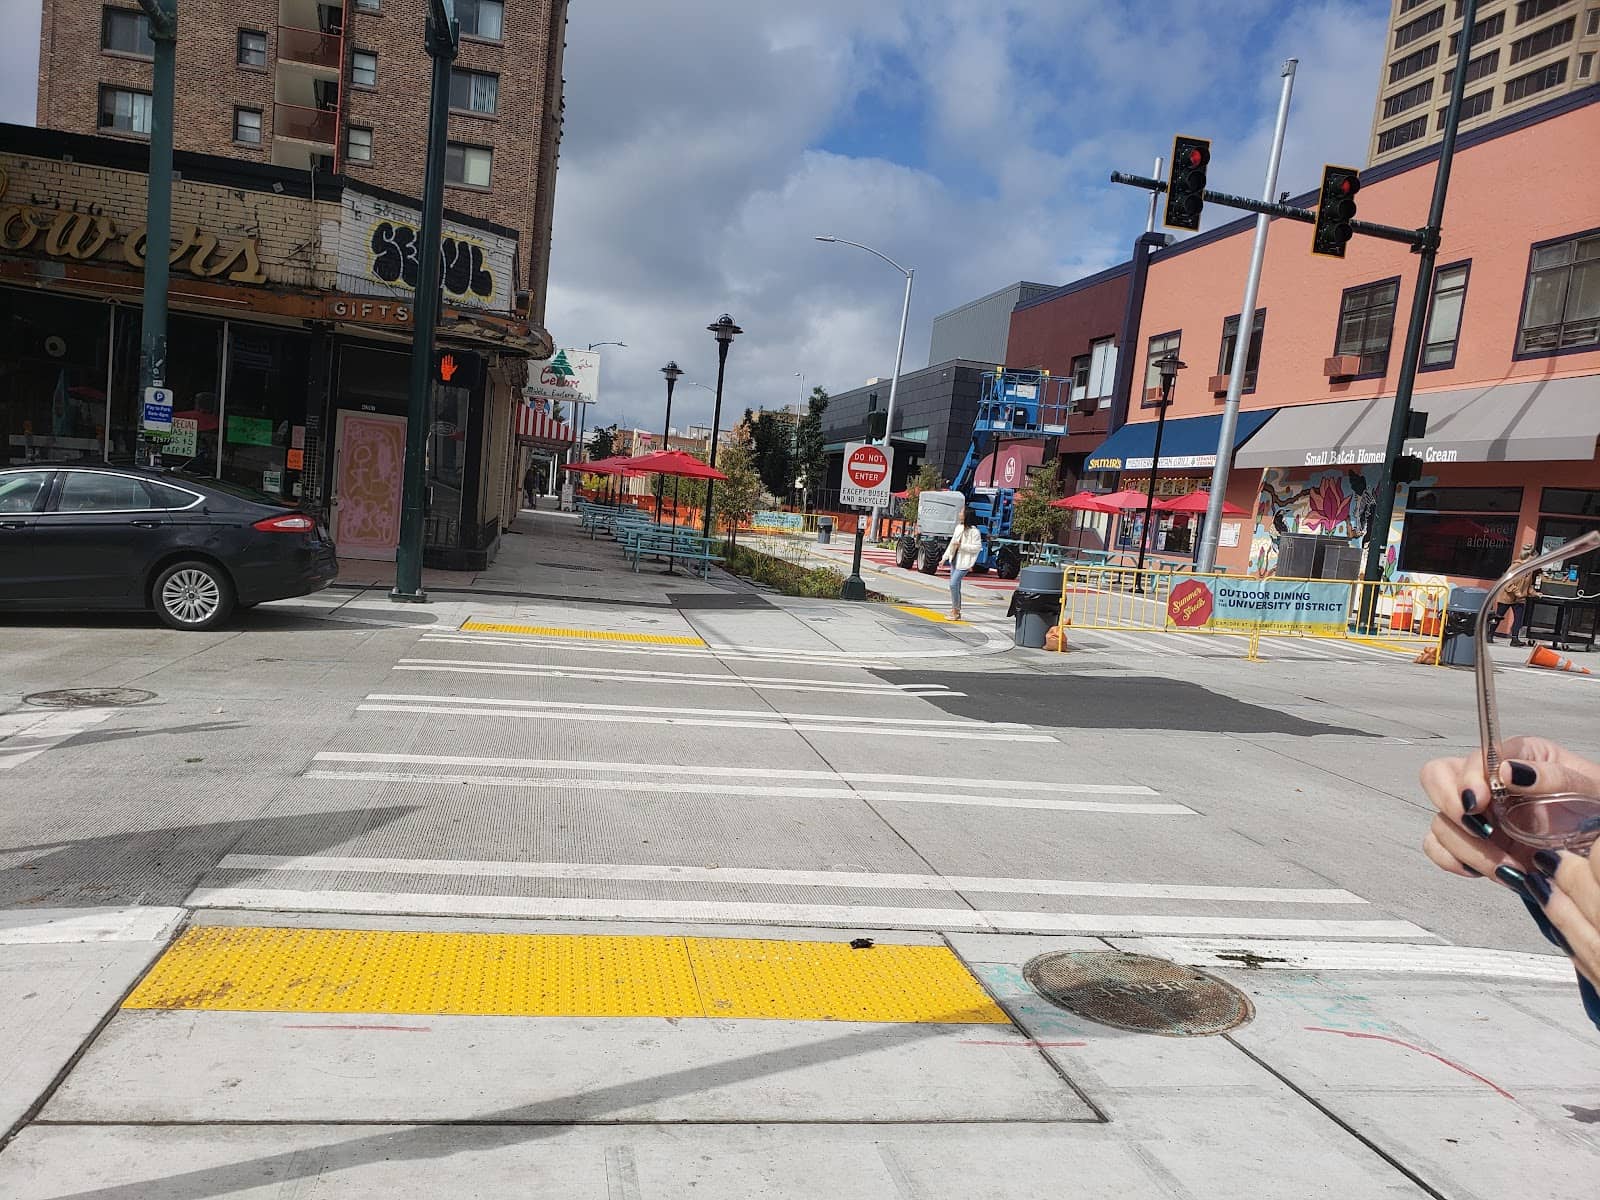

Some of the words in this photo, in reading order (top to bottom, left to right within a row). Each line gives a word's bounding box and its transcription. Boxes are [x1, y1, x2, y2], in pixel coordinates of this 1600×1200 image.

[0, 168, 267, 284] owers
[334, 302, 409, 321] GIFTS
[868, 454, 883, 462] NOT
[1304, 452, 1327, 465] Small
[1329, 450, 1356, 464] Batch
[1408, 447, 1423, 460] Ice
[1425, 447, 1457, 461] Cream
[855, 472, 878, 481] ENTER
[858, 497, 887, 505] BICYCLES
[1172, 587, 1202, 614] Summer
[1219, 588, 1270, 600] OUTDOOR
[1274, 591, 1310, 601] DINING
[1228, 600, 1291, 610] UNIVERSITY
[1295, 602, 1343, 612] DISTRICT
